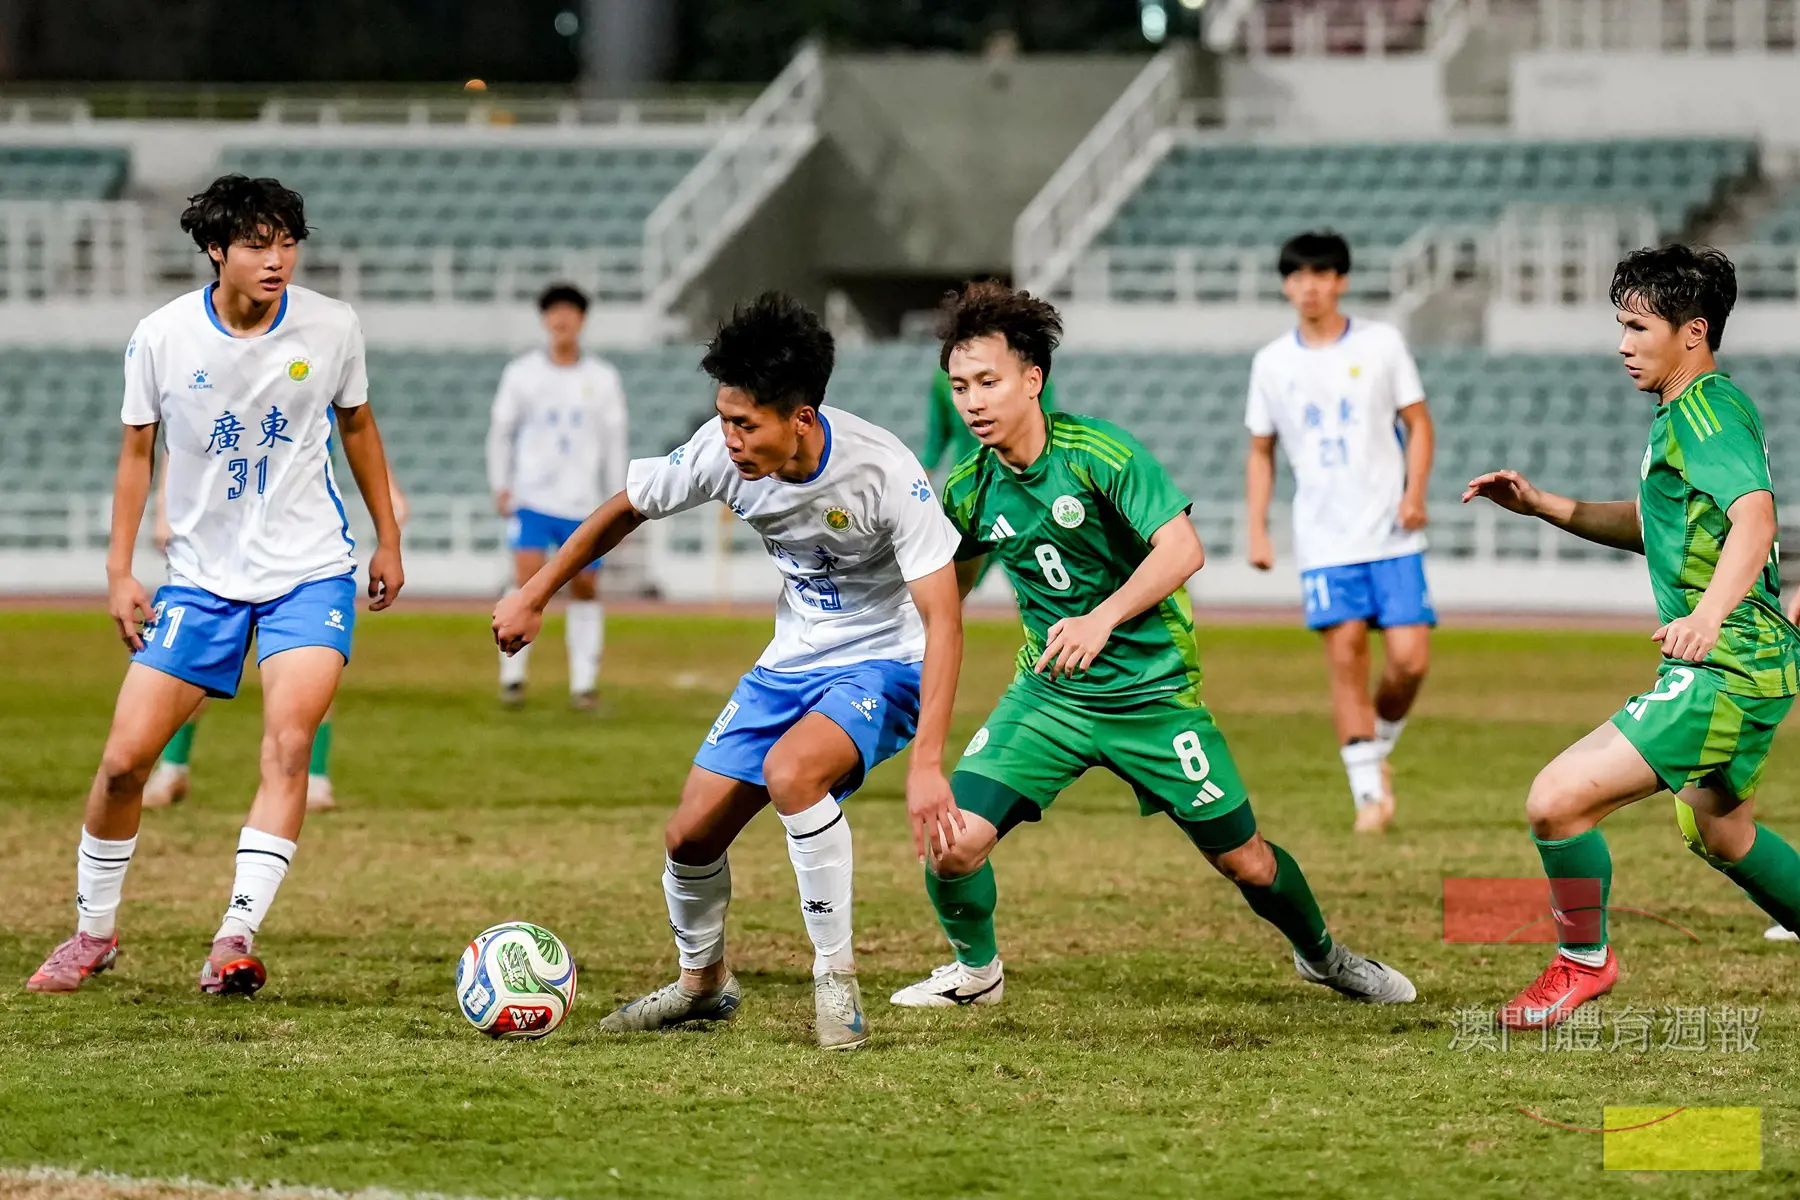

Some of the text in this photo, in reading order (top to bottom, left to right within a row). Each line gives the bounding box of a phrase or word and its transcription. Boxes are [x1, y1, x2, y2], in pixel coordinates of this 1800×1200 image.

[205, 405, 293, 455] 廣東
[227, 455, 268, 500] 31
[1034, 543, 1071, 590] 8
[850, 700, 873, 722] KELME
[1172, 730, 1210, 781] 8
